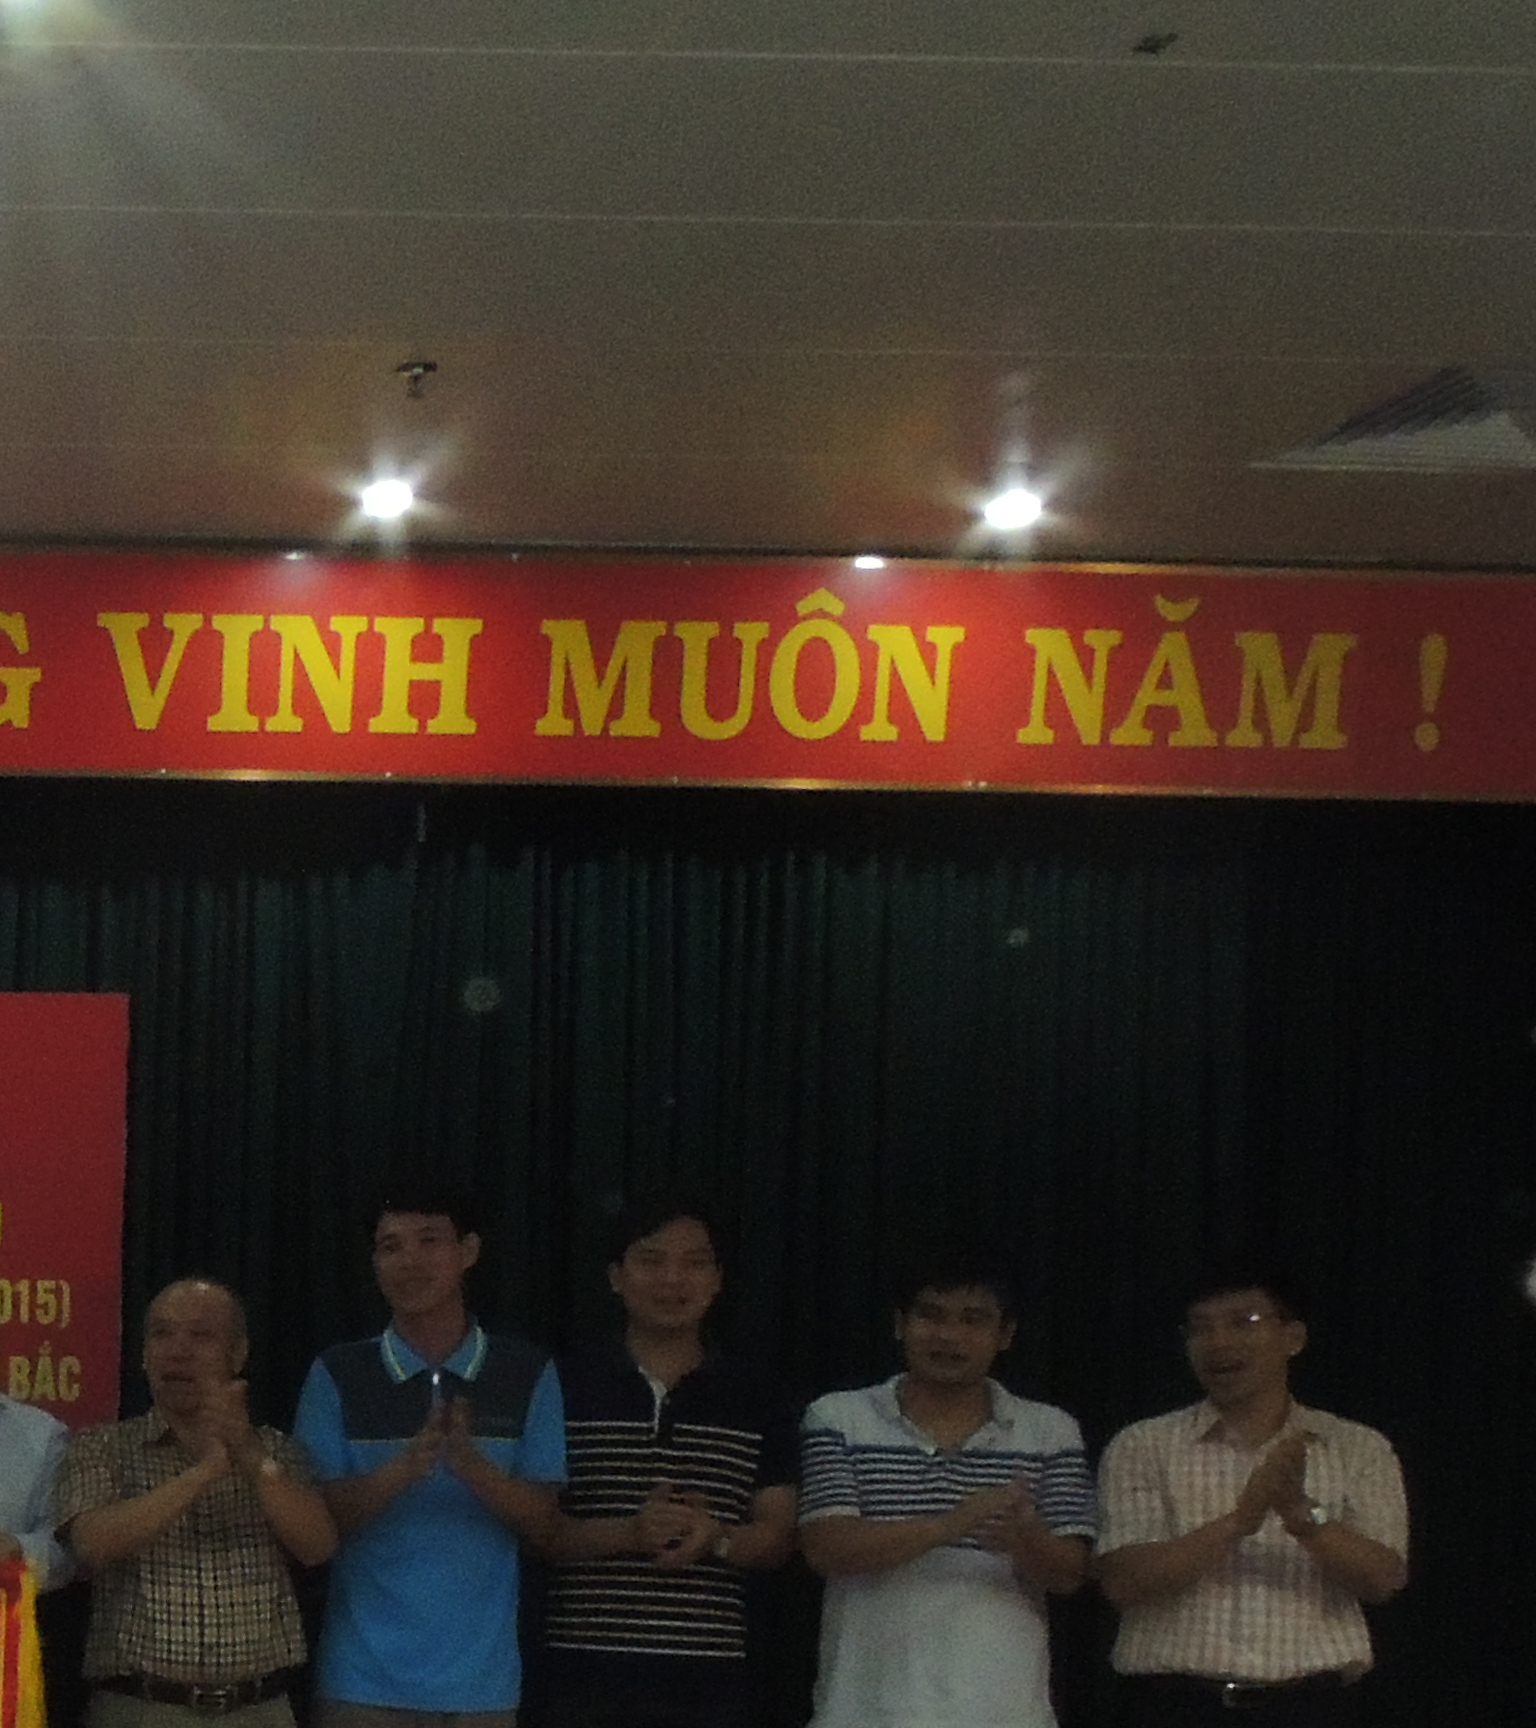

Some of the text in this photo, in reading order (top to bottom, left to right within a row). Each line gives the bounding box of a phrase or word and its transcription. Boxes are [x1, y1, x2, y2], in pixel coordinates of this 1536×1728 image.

[98, 611, 484, 736] VINH
[534, 587, 966, 743] MUÔN
[1015, 593, 1358, 750] NĂM
[7, 1340, 82, 1401] BẮC
